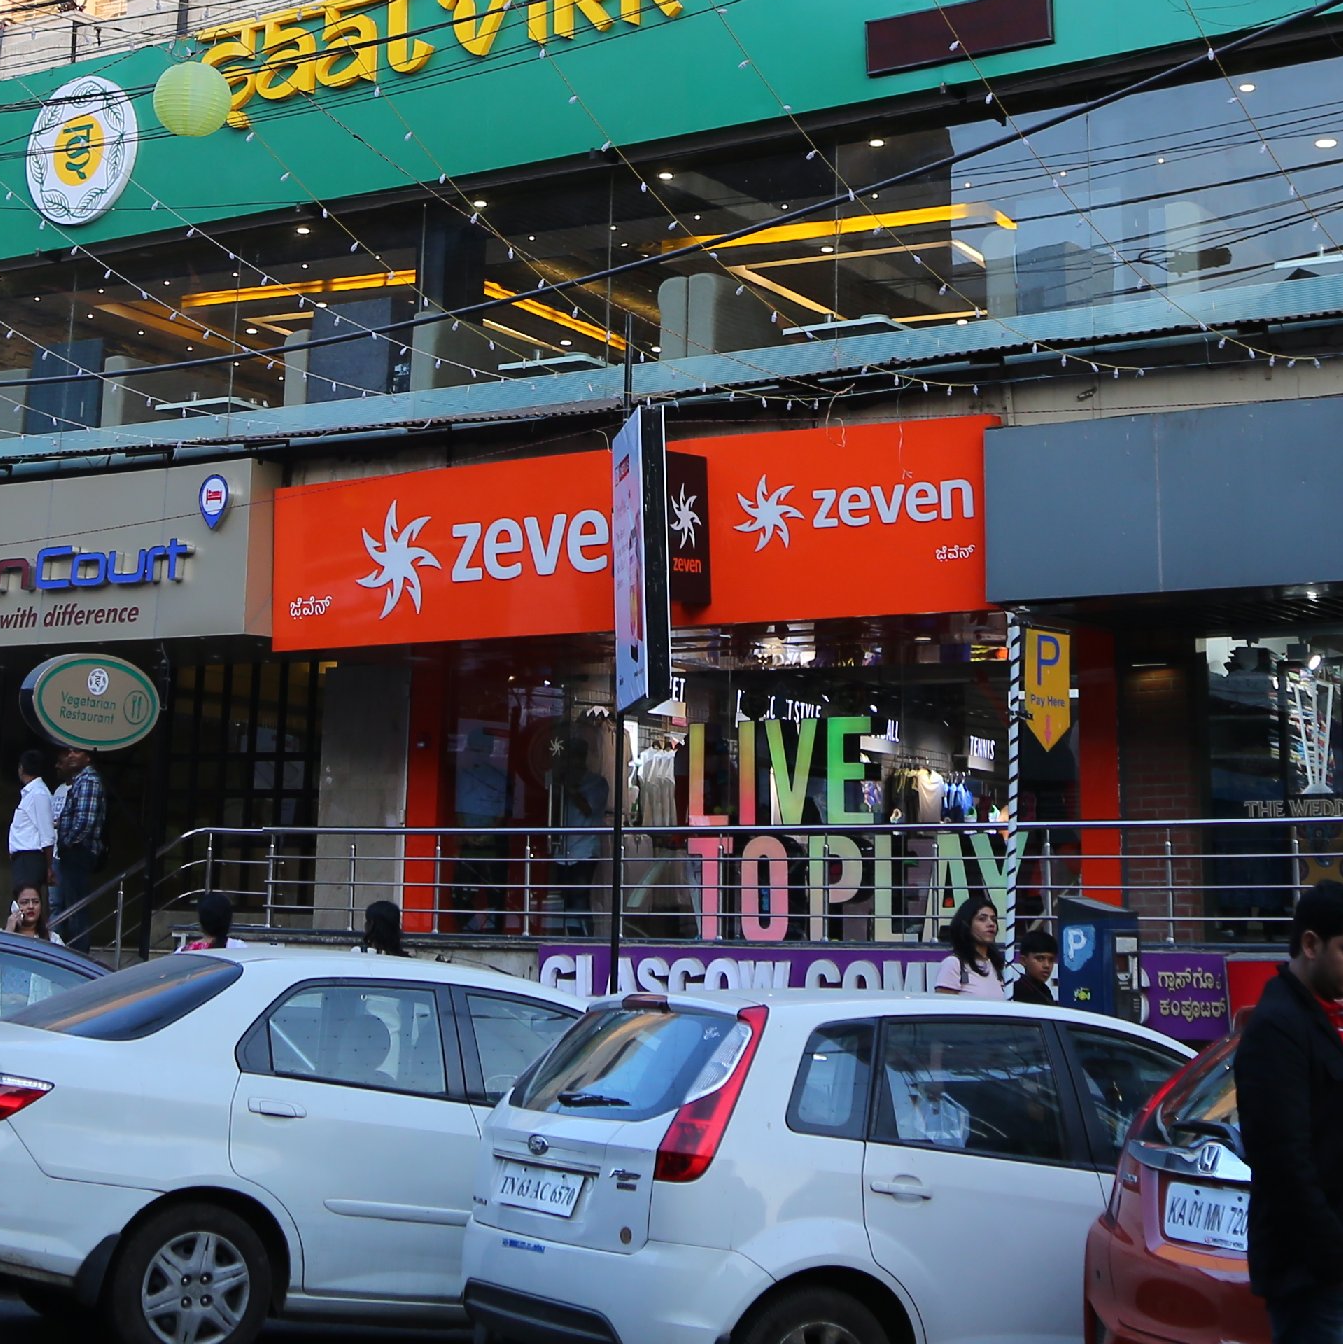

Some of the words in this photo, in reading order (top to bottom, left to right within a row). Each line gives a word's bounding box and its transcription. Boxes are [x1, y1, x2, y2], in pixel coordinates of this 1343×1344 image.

[811, 476, 975, 530] zeven
[451, 509, 611, 583] zeve
[36, 538, 189, 590] Court
[672, 557, 702, 573] zeven
[0, 606, 38, 629] with
[43, 603, 140, 627] difference
[1035, 635, 1060, 685] P
[59, 706, 114, 724] Restaurant
[61, 691, 116, 711] Vegetarian
[1030, 695, 1045, 708] Pay
[1047, 696, 1066, 708] Here
[969, 735, 996, 760] TENNIS
[688, 716, 875, 826] LIVE
[1244, 800, 1285, 818] THE
[687, 836, 789, 941] TO
[809, 833, 1029, 942] PLAY
[1064, 928, 1087, 958] P
[540, 954, 792, 997] GLASGOW
[501, 1175, 519, 1195] TN
[518, 1178, 532, 1198] 63
[531, 1181, 551, 1201] AC
[1167, 1197, 1186, 1226] KA
[1204, 1203, 1226, 1232] MN
[1226, 1206, 1248, 1236] 720
